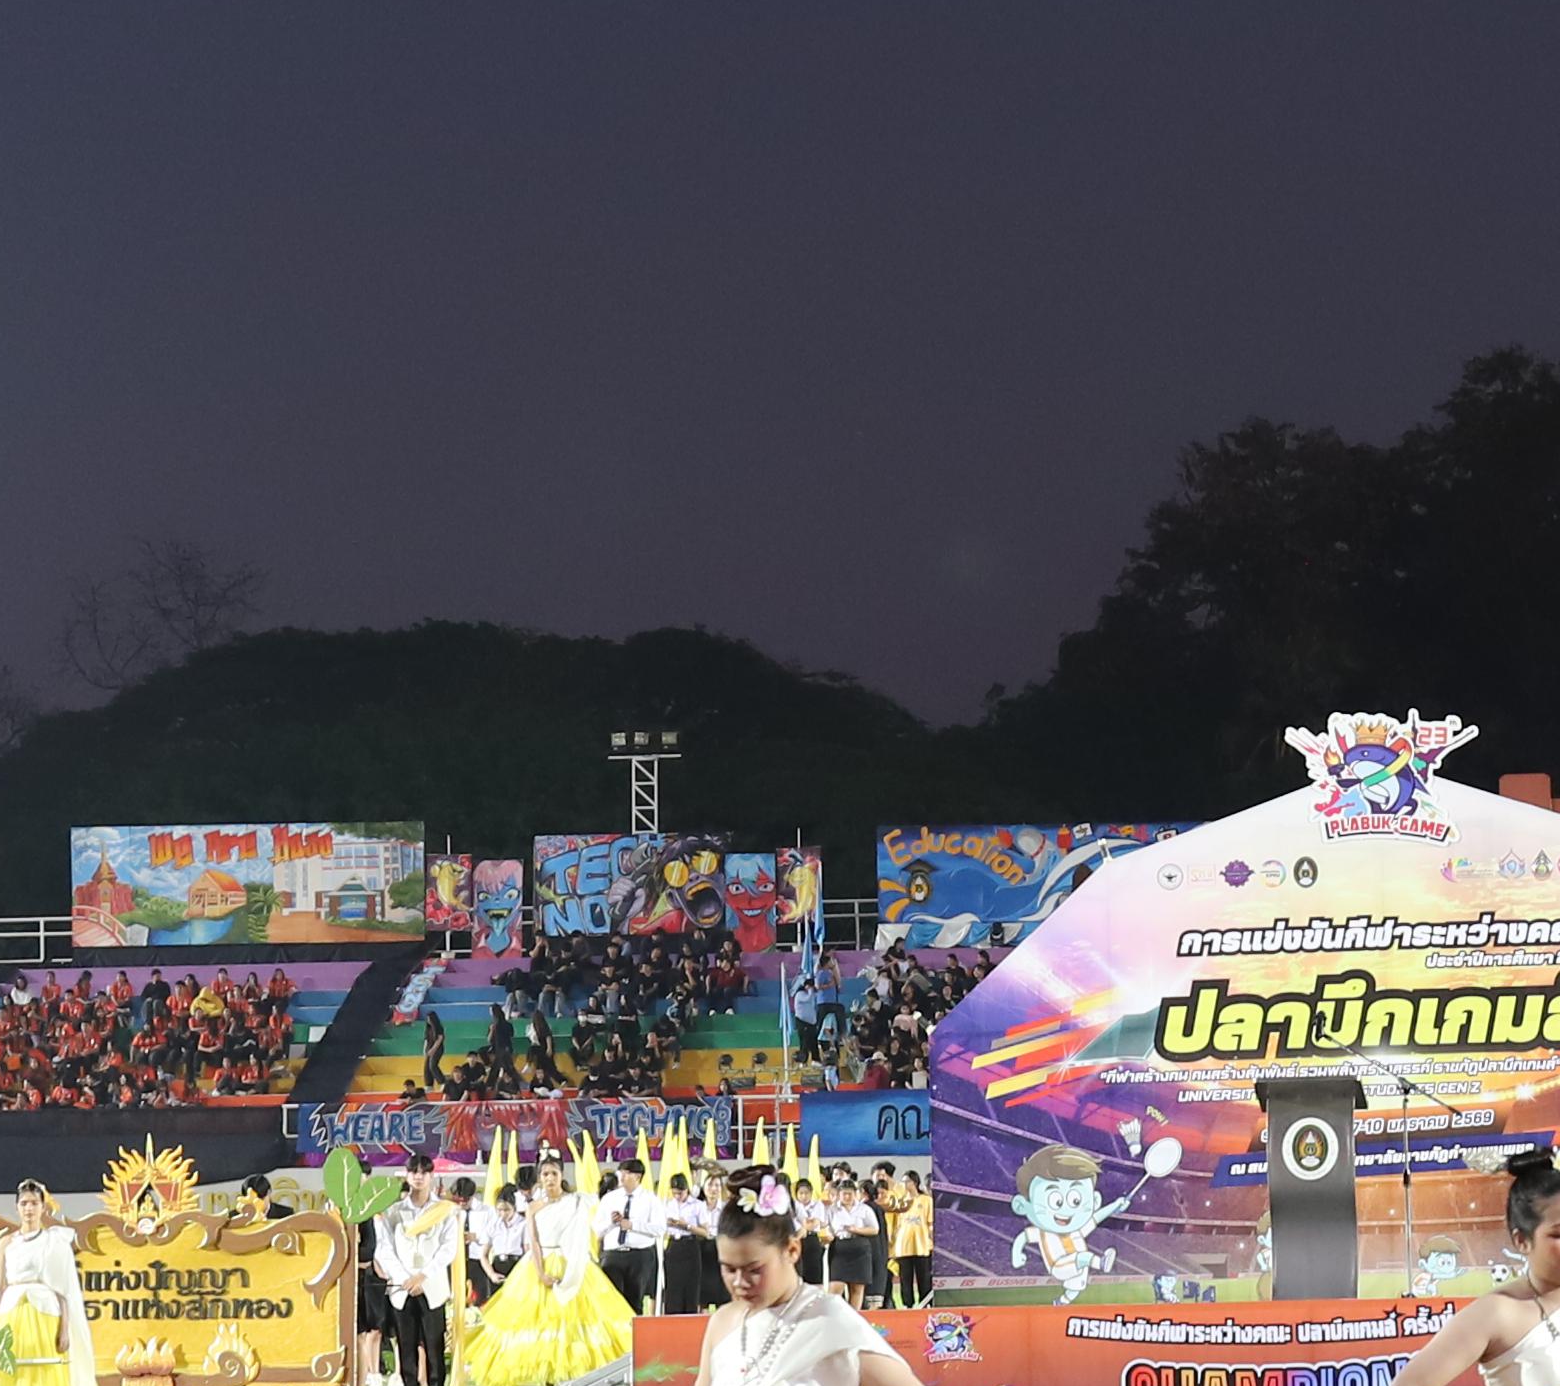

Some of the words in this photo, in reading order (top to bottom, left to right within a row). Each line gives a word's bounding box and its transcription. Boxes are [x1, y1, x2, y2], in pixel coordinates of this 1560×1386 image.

[1416, 726, 1448, 745] 23
[1329, 816, 1391, 834] PLABUK
[1399, 816, 1447, 837] GAME
[1426, 950, 1554, 968] ประจำปีการศึกษา
[1178, 1088, 1256, 1103] UNIVERSIT
[1436, 1081, 1470, 1095] GEN
[1471, 1081, 1483, 1094] Z
[877, 1104, 931, 1140] คณ
[78, 1260, 250, 1296] แห่งปัญญา
